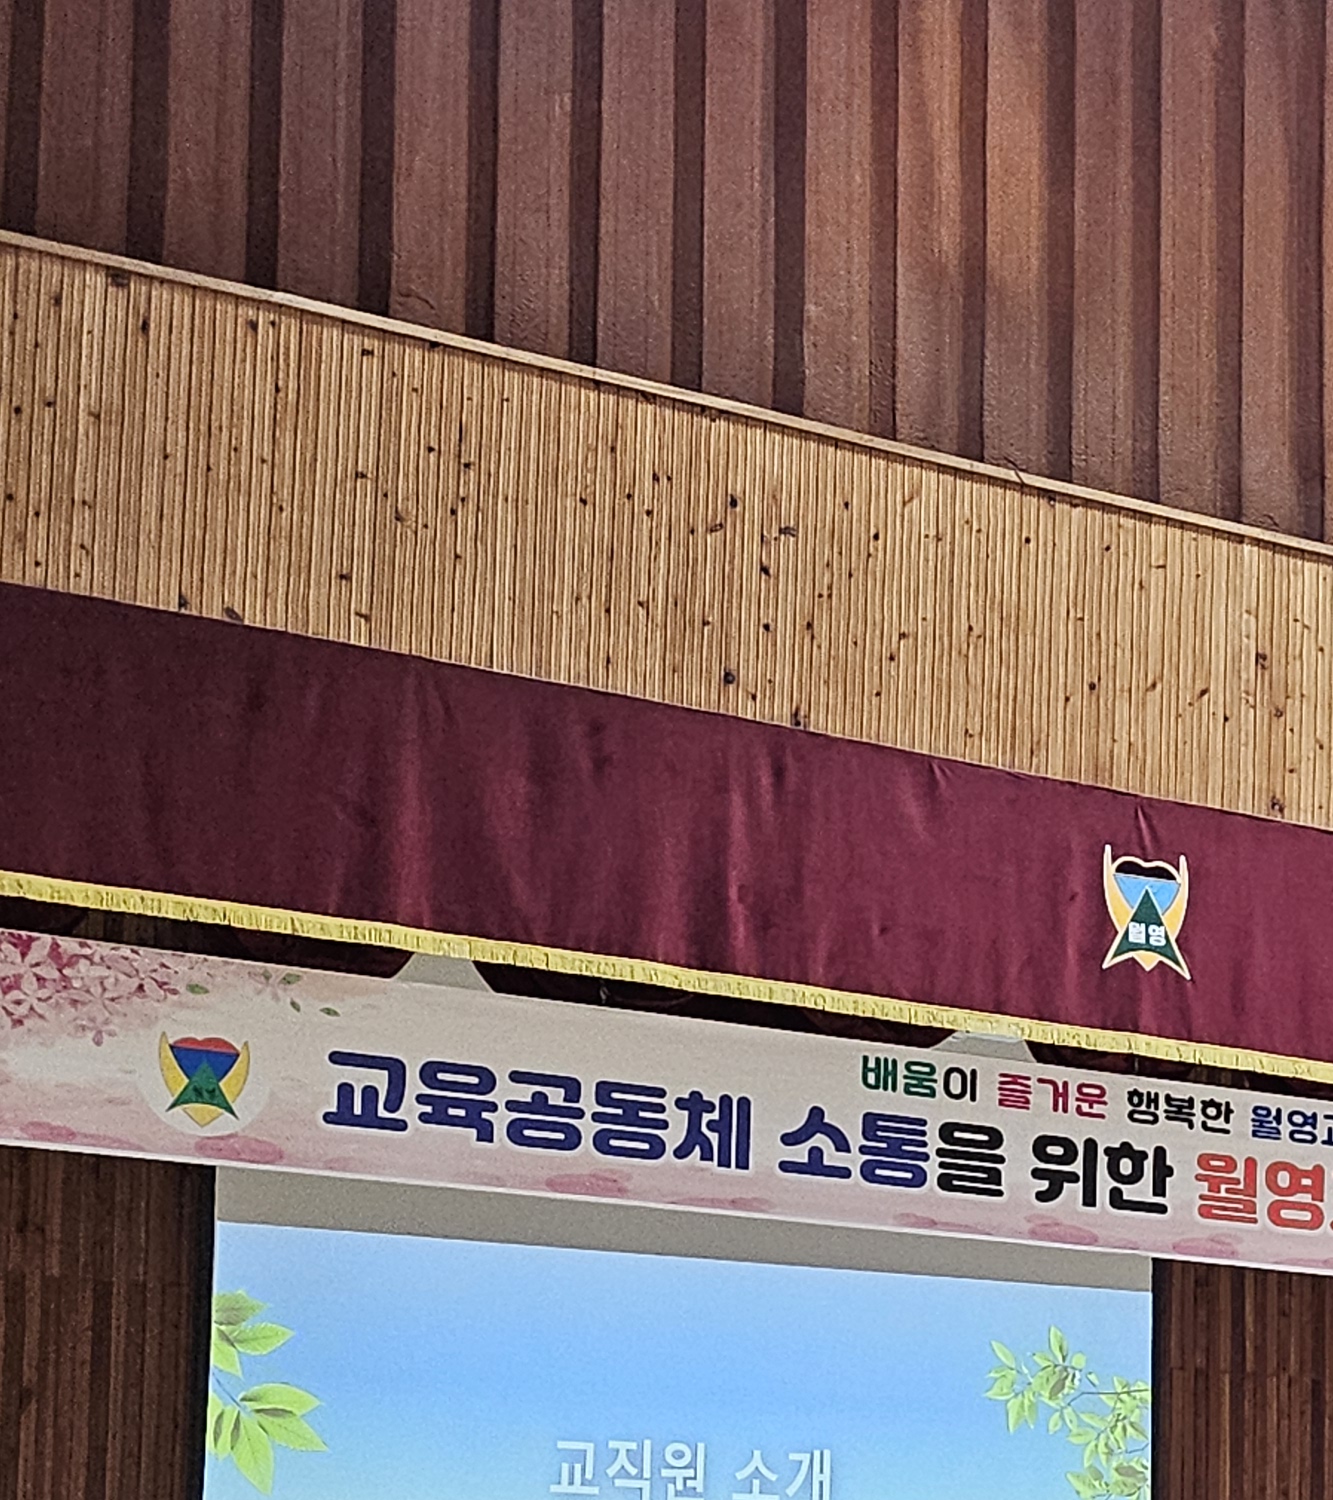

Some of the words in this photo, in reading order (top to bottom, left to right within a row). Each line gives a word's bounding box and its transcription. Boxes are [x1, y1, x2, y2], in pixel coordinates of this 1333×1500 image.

[1127, 921, 1167, 947] 월영
[321, 1049, 752, 1171] 교육공동체
[777, 1105, 1007, 1199] 소통을
[1030, 1133, 1175, 1216] 위한
[861, 1054, 978, 1102] 배움이
[997, 1072, 1109, 1120] 즐거운
[1126, 1087, 1235, 1136] 행복한
